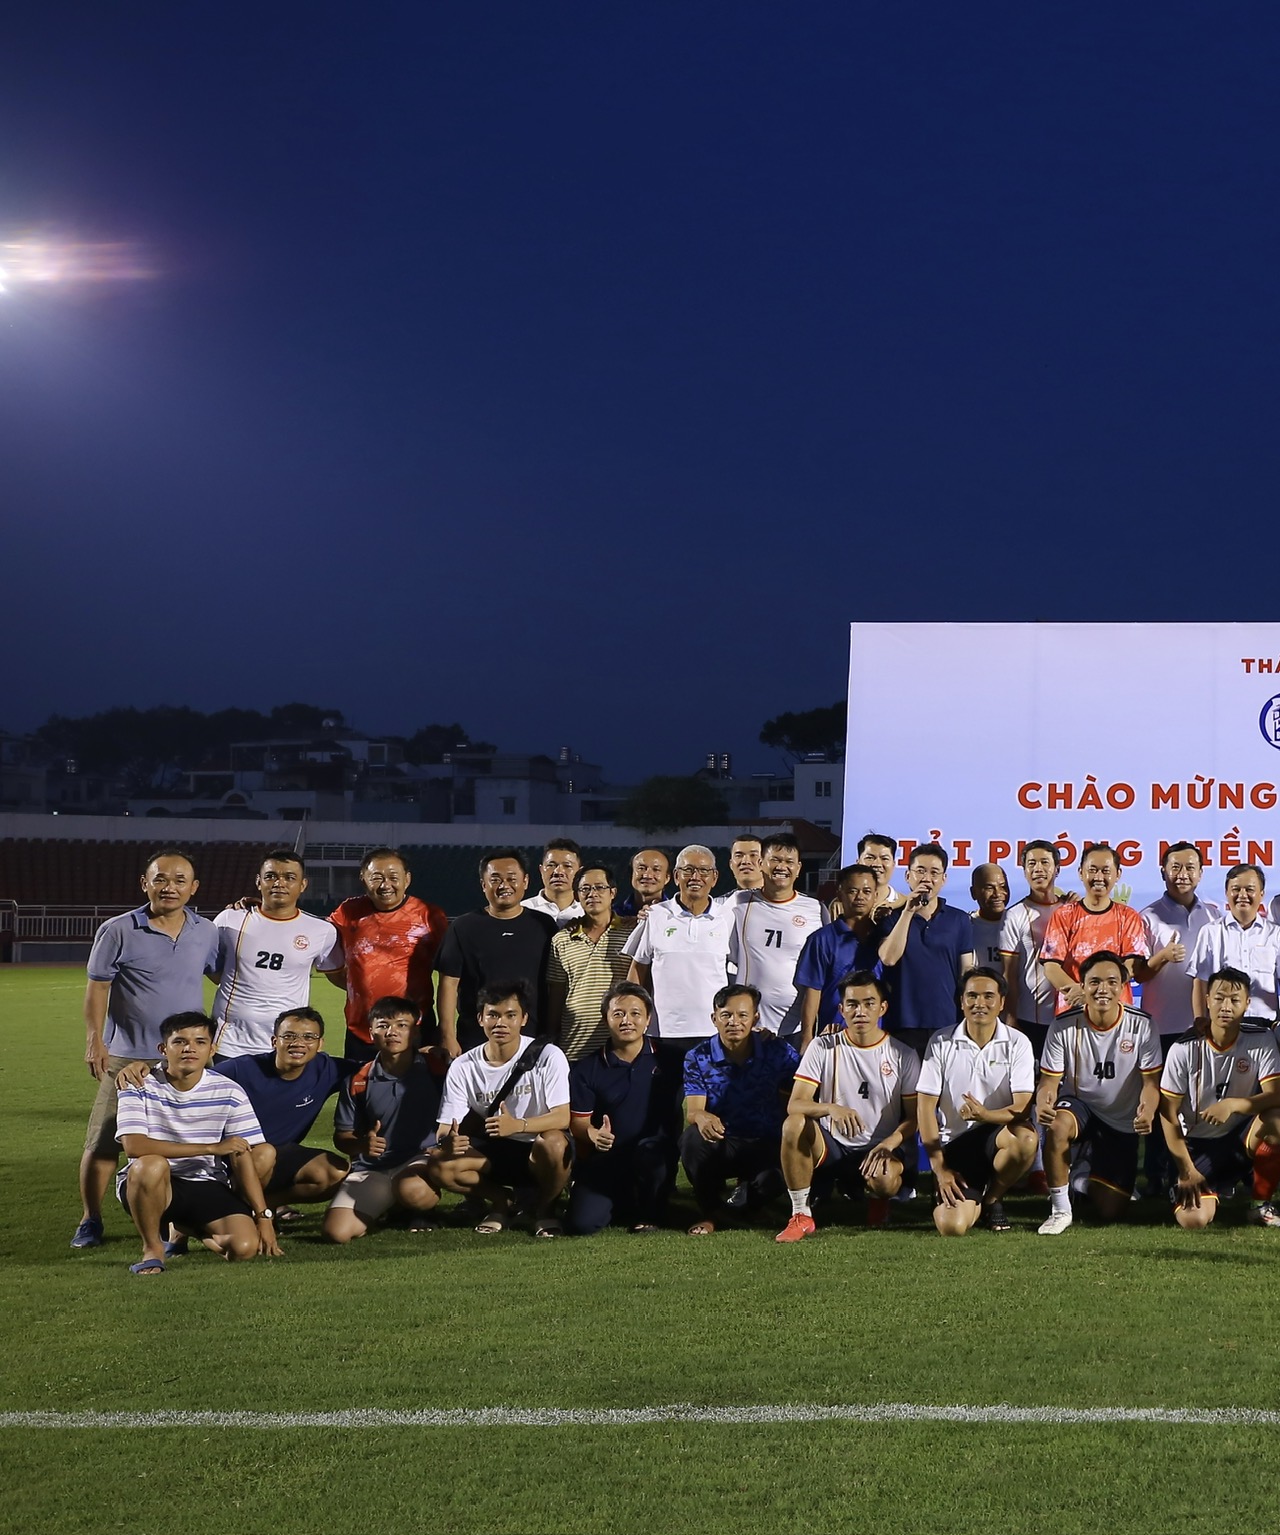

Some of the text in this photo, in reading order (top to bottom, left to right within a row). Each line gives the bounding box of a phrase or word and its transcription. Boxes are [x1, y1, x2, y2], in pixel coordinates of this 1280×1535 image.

[1017, 774, 1136, 810] CHÀO
[1151, 774, 1278, 810] MỪNG
[764, 929, 783, 948] 71
[255, 951, 284, 971] 28
[1093, 1061, 1116, 1080] 40
[857, 1081, 869, 1099] 4
